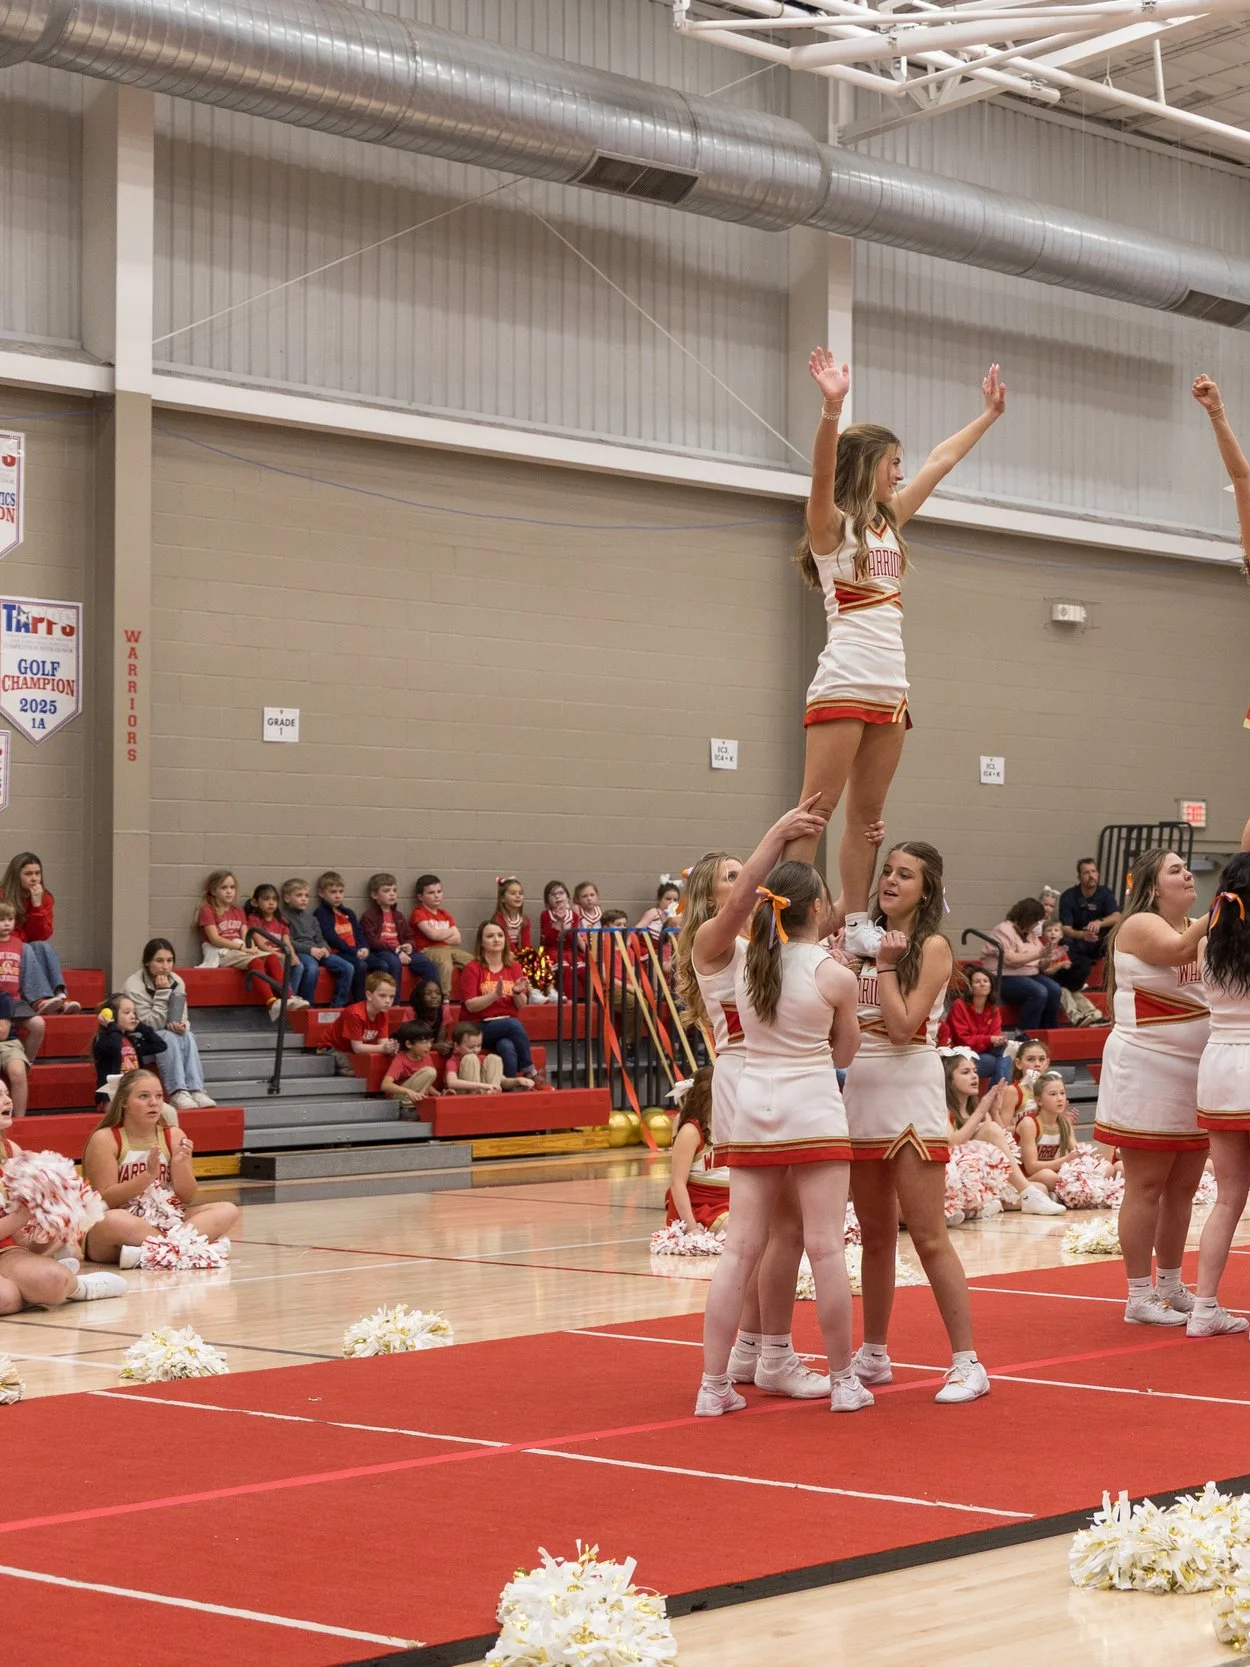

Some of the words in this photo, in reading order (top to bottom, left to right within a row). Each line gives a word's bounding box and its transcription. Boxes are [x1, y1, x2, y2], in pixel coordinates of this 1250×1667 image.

[18, 659, 60, 677] GOLF
[2, 675, 75, 697] CHAMPION
[125, 629, 141, 762] WARRIORS
[20, 698, 57, 714] 2025
[32, 718, 45, 729] 1A
[268, 718, 295, 726] GRADE
